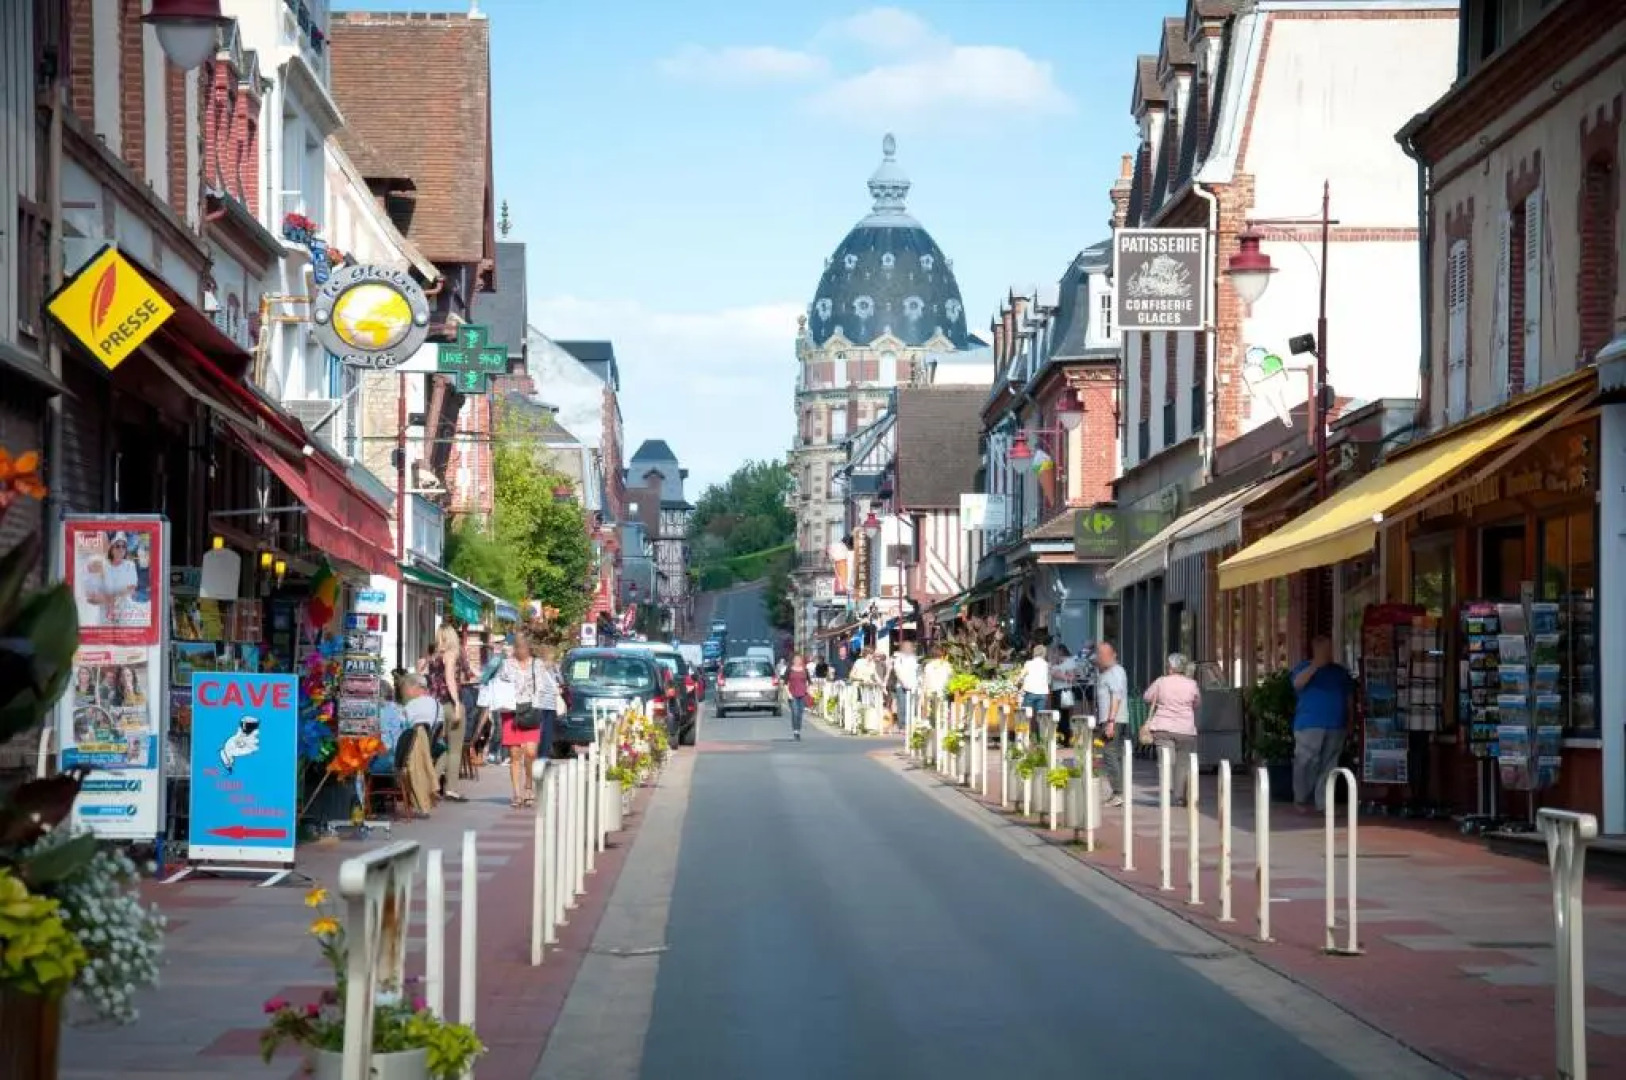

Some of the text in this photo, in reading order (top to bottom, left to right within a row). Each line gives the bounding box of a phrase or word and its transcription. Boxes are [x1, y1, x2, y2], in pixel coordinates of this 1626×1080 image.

[1121, 236, 1200, 253] PATISSERIE
[1125, 299, 1193, 311] CONFISERIE
[1138, 312, 1181, 323] GLACES
[100, 299, 159, 355] PRESSE
[197, 681, 291, 709] CAVE
